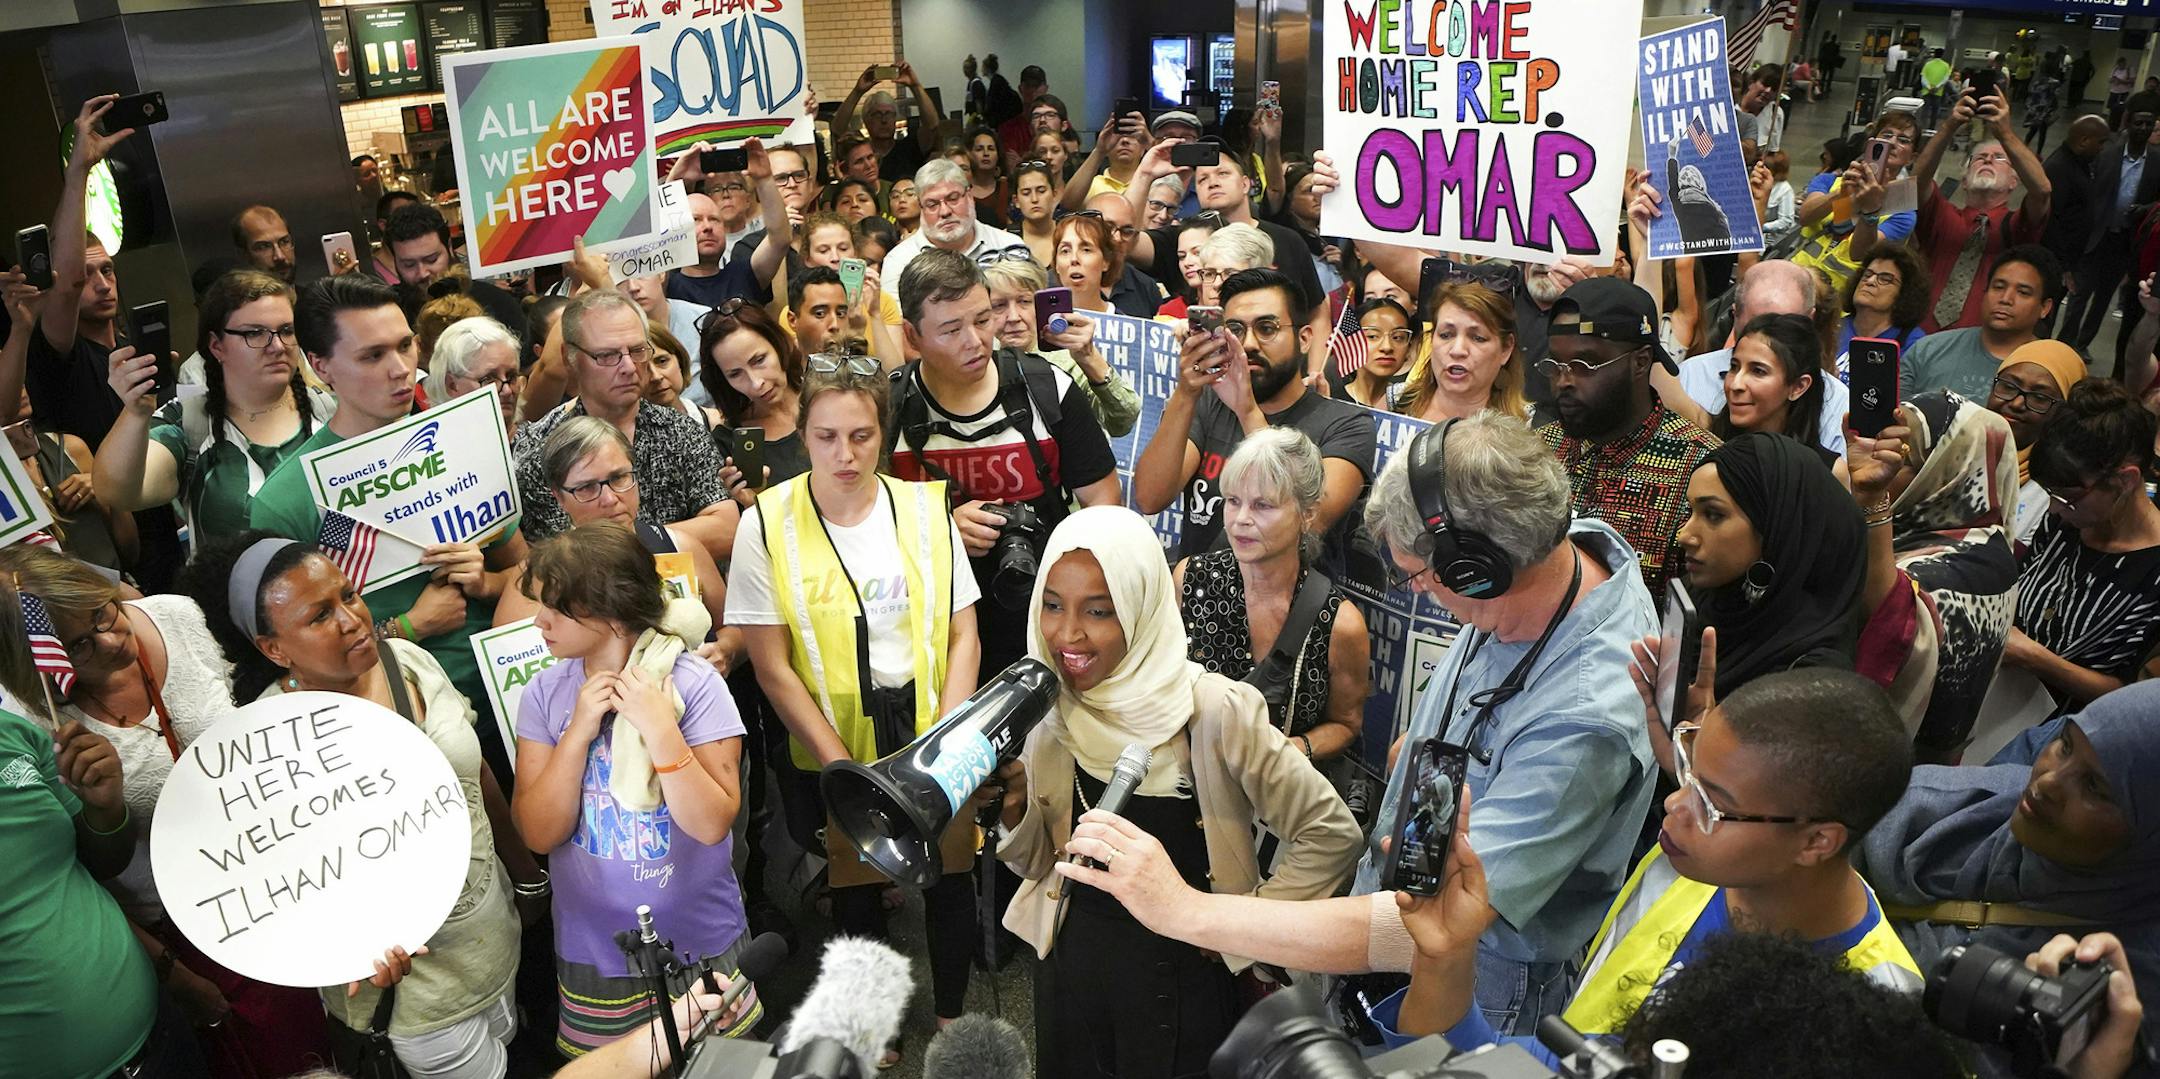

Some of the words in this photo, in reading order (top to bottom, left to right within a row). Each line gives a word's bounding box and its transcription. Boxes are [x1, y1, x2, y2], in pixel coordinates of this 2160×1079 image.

[1345, 0, 1531, 60] WELCOME
[1645, 28, 1719, 75] STAND
[478, 100, 550, 141] ALL
[558, 87, 633, 130] ARE
[1338, 57, 1438, 118] HOME
[1456, 58, 1564, 128] REP.
[1652, 67, 1715, 108] WITH
[480, 131, 635, 180] WELCOME
[485, 174, 598, 226] HERE
[1355, 128, 1601, 255] OMAR
[622, 249, 674, 277] OMAR
[1093, 319, 1136, 344] AND
[1150, 326, 1183, 354] STA
[328, 462, 377, 487] Council
[378, 459, 388, 470] 5
[337, 450, 447, 511] AFSCME
[384, 490, 442, 524] stands
[446, 471, 479, 497] with
[431, 489, 512, 544] Ilhan
[497, 644, 544, 666] Council
[194, 705, 352, 779] UNITE
[219, 743, 351, 821] HERE
[199, 768, 396, 871] WELCOMES
[196, 846, 342, 943] ILHAN
[358, 782, 465, 860] OMAR!
[630, 861, 676, 889] things
